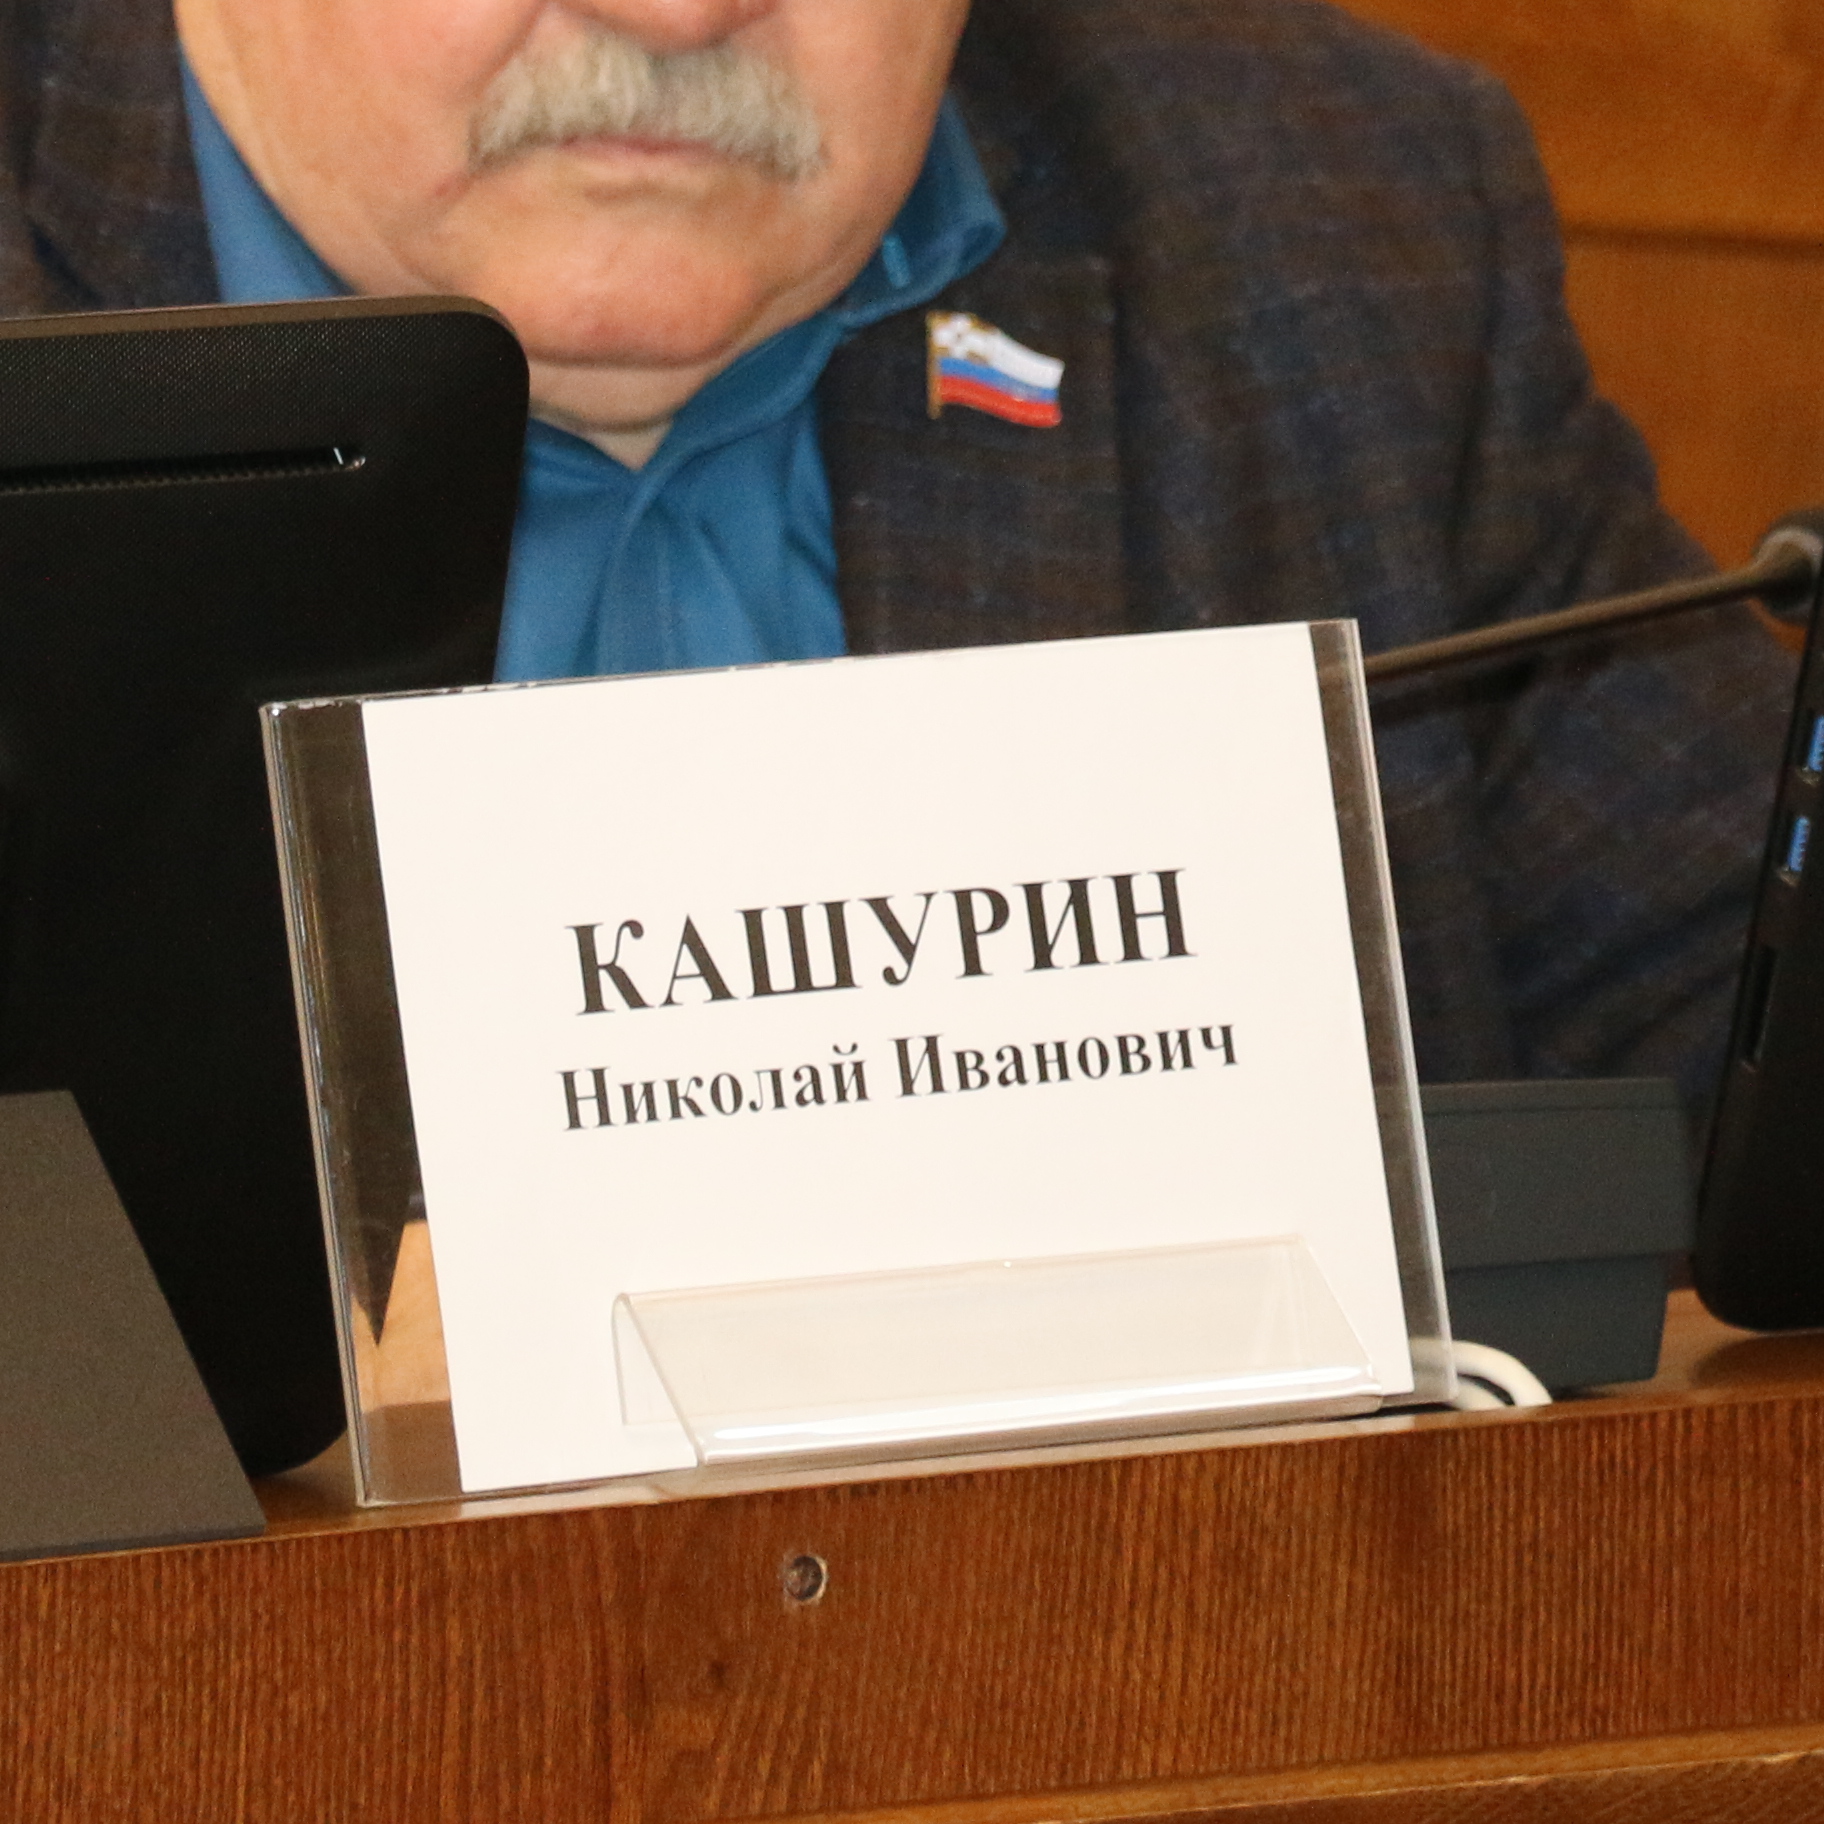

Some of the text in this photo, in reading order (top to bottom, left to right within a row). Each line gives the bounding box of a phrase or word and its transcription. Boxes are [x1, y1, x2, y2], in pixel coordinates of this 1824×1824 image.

[563, 867, 1199, 1017] КАШУРИН
[556, 1022, 1241, 1132] Николай Иванович
